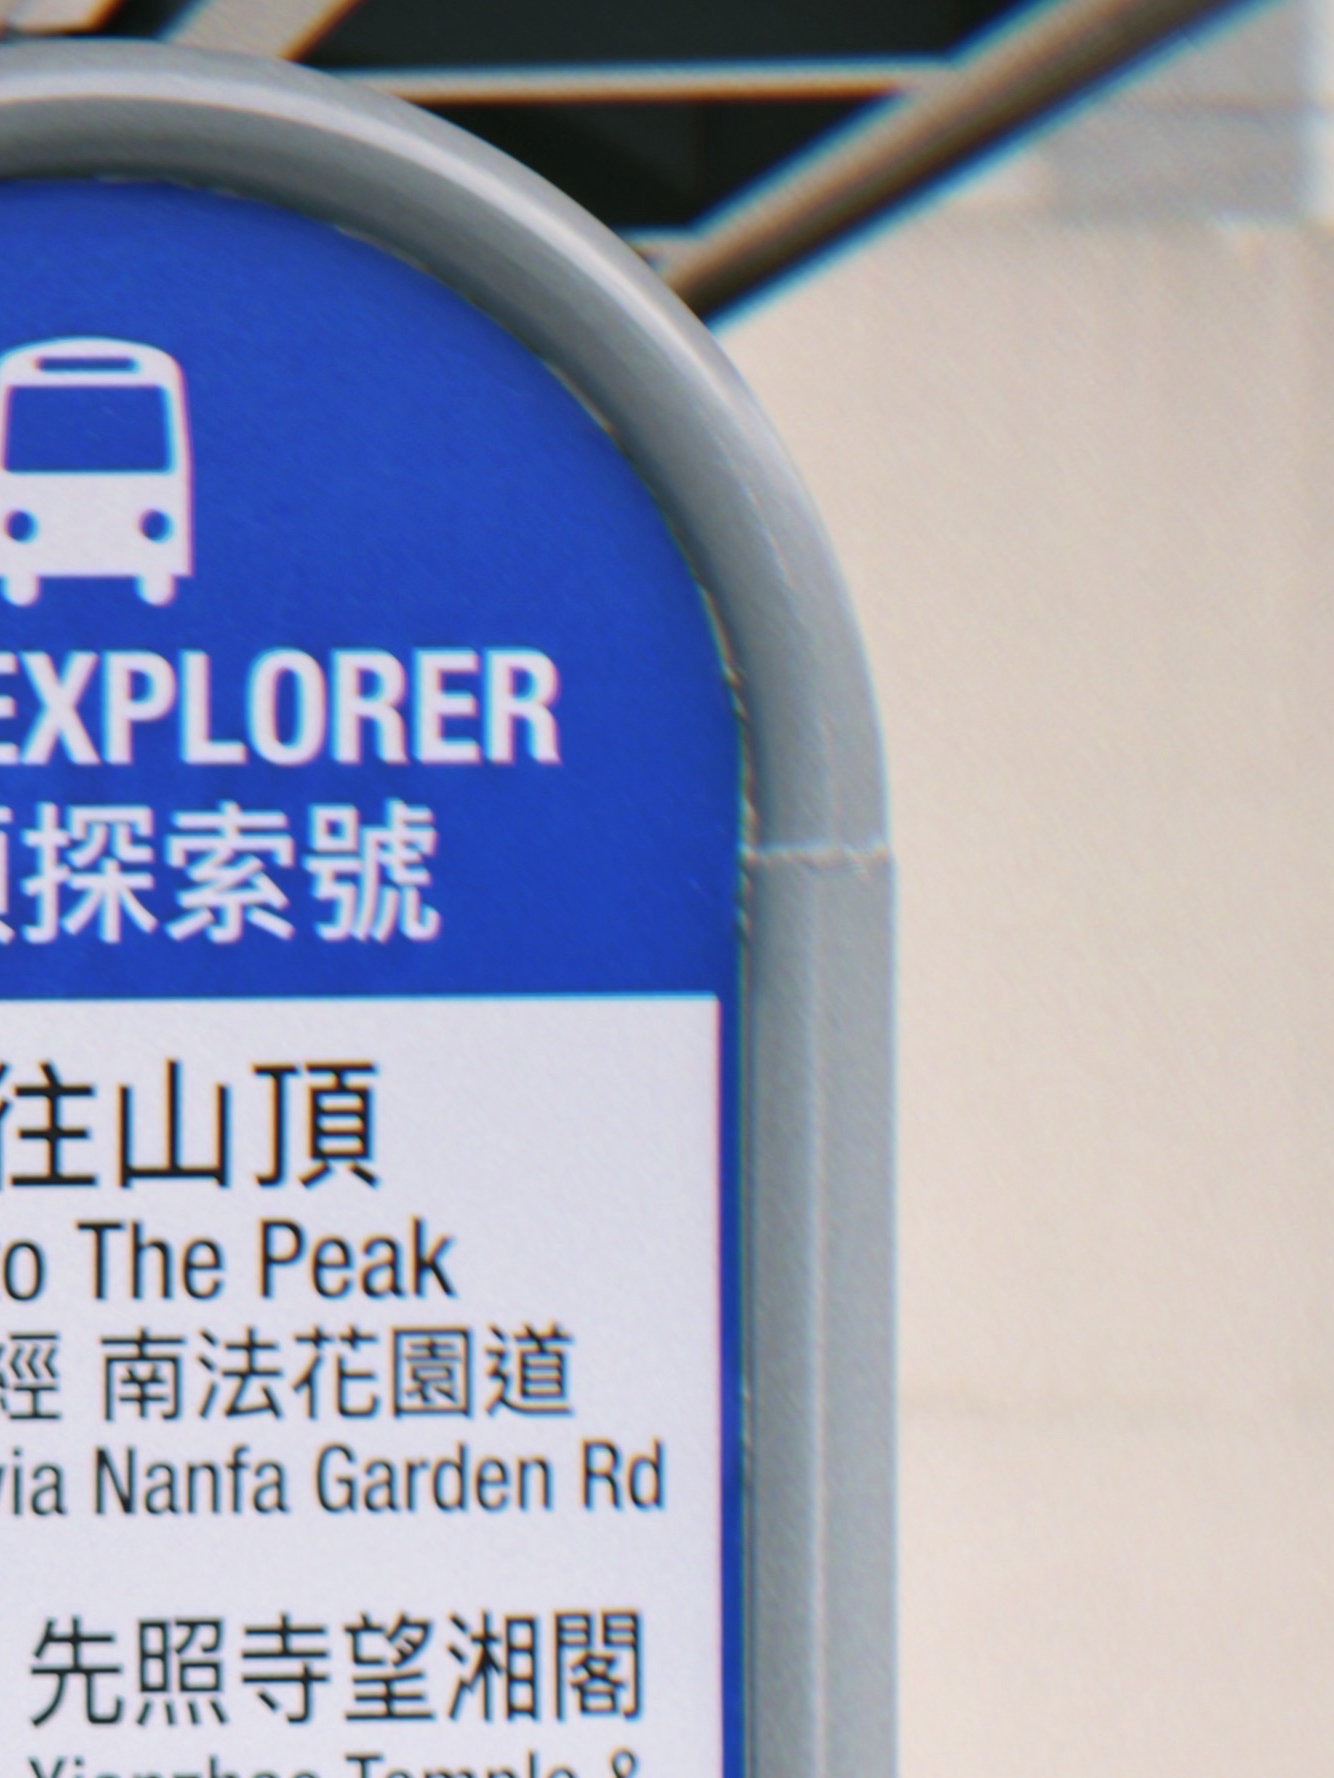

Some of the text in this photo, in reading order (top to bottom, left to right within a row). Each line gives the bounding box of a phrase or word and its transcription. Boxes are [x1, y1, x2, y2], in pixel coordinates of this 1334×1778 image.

[77, 1221, 223, 1300] The
[261, 1218, 454, 1298] Peak
[101, 1325, 571, 1421] 南法花園道
[95, 1446, 288, 1515] Nanfa
[316, 1444, 551, 1513] Garden
[583, 1440, 663, 1509] Rd
[31, 1611, 641, 1727] 先照寺望湘閣
